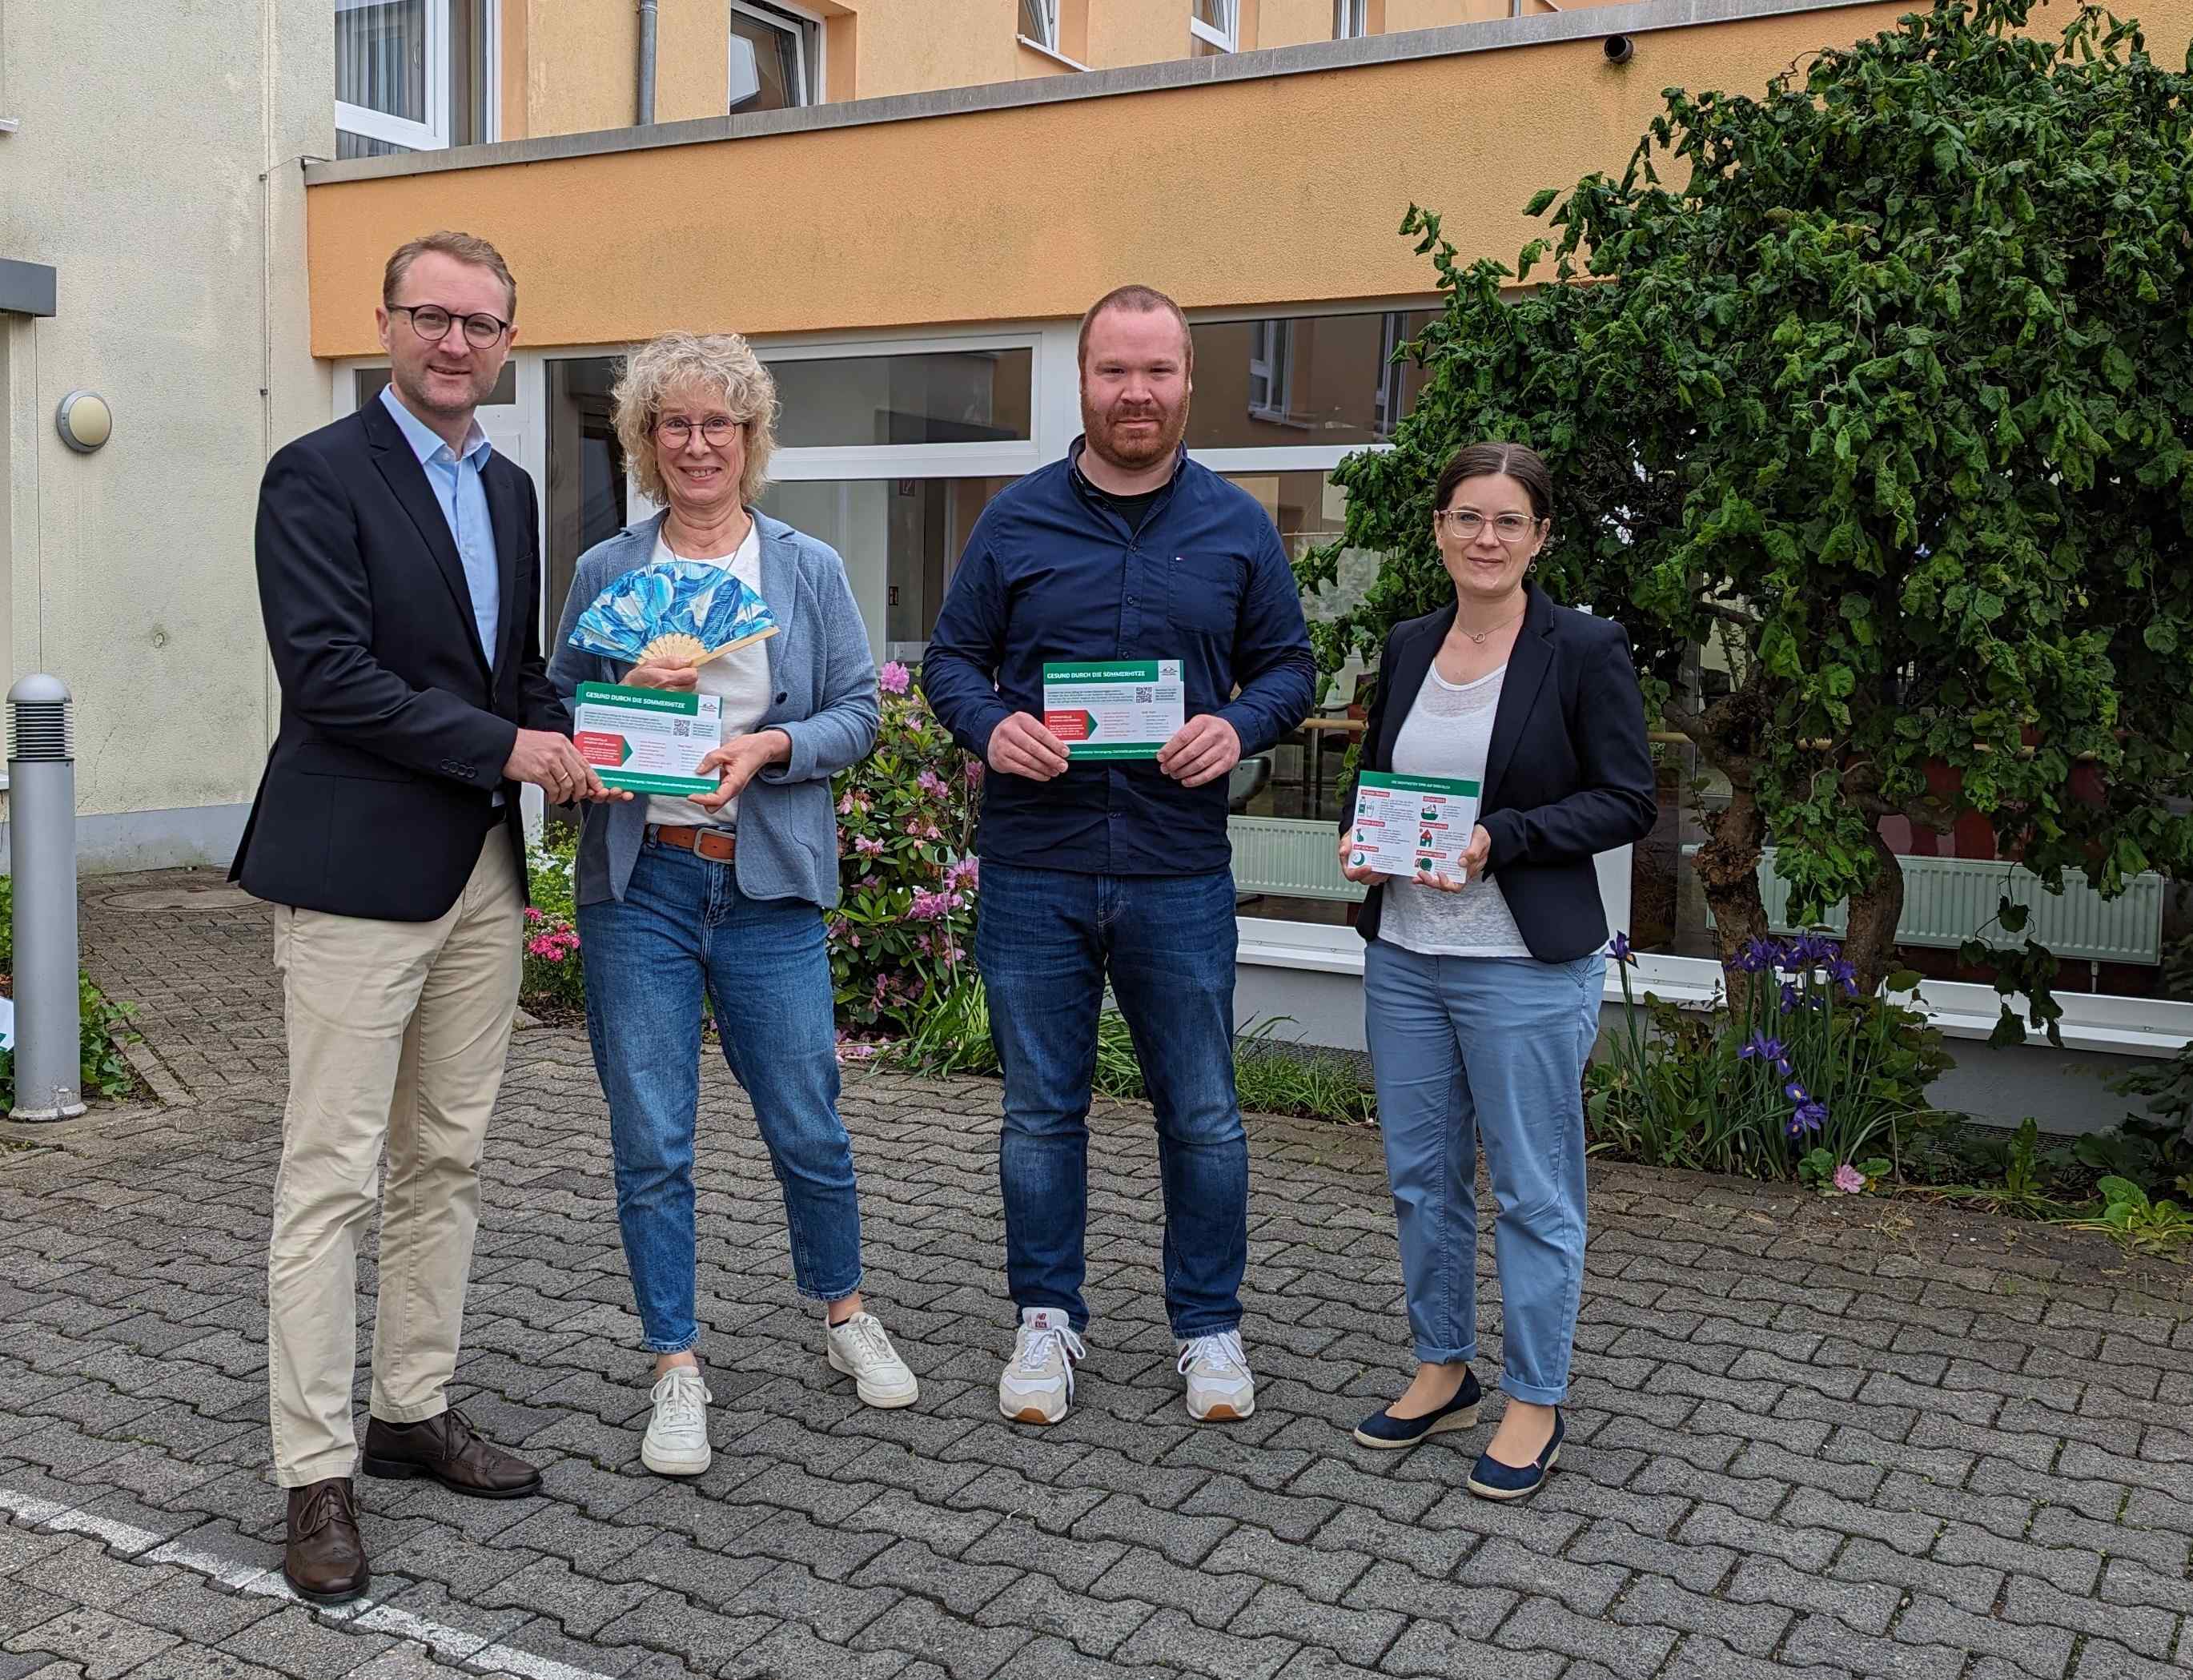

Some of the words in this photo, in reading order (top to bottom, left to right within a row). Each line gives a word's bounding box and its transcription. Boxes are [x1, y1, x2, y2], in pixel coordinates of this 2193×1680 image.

[585, 691, 609, 700] GESUND
[611, 694, 631, 702] DURCH
[643, 698, 685, 709] SOMMERHITZE
